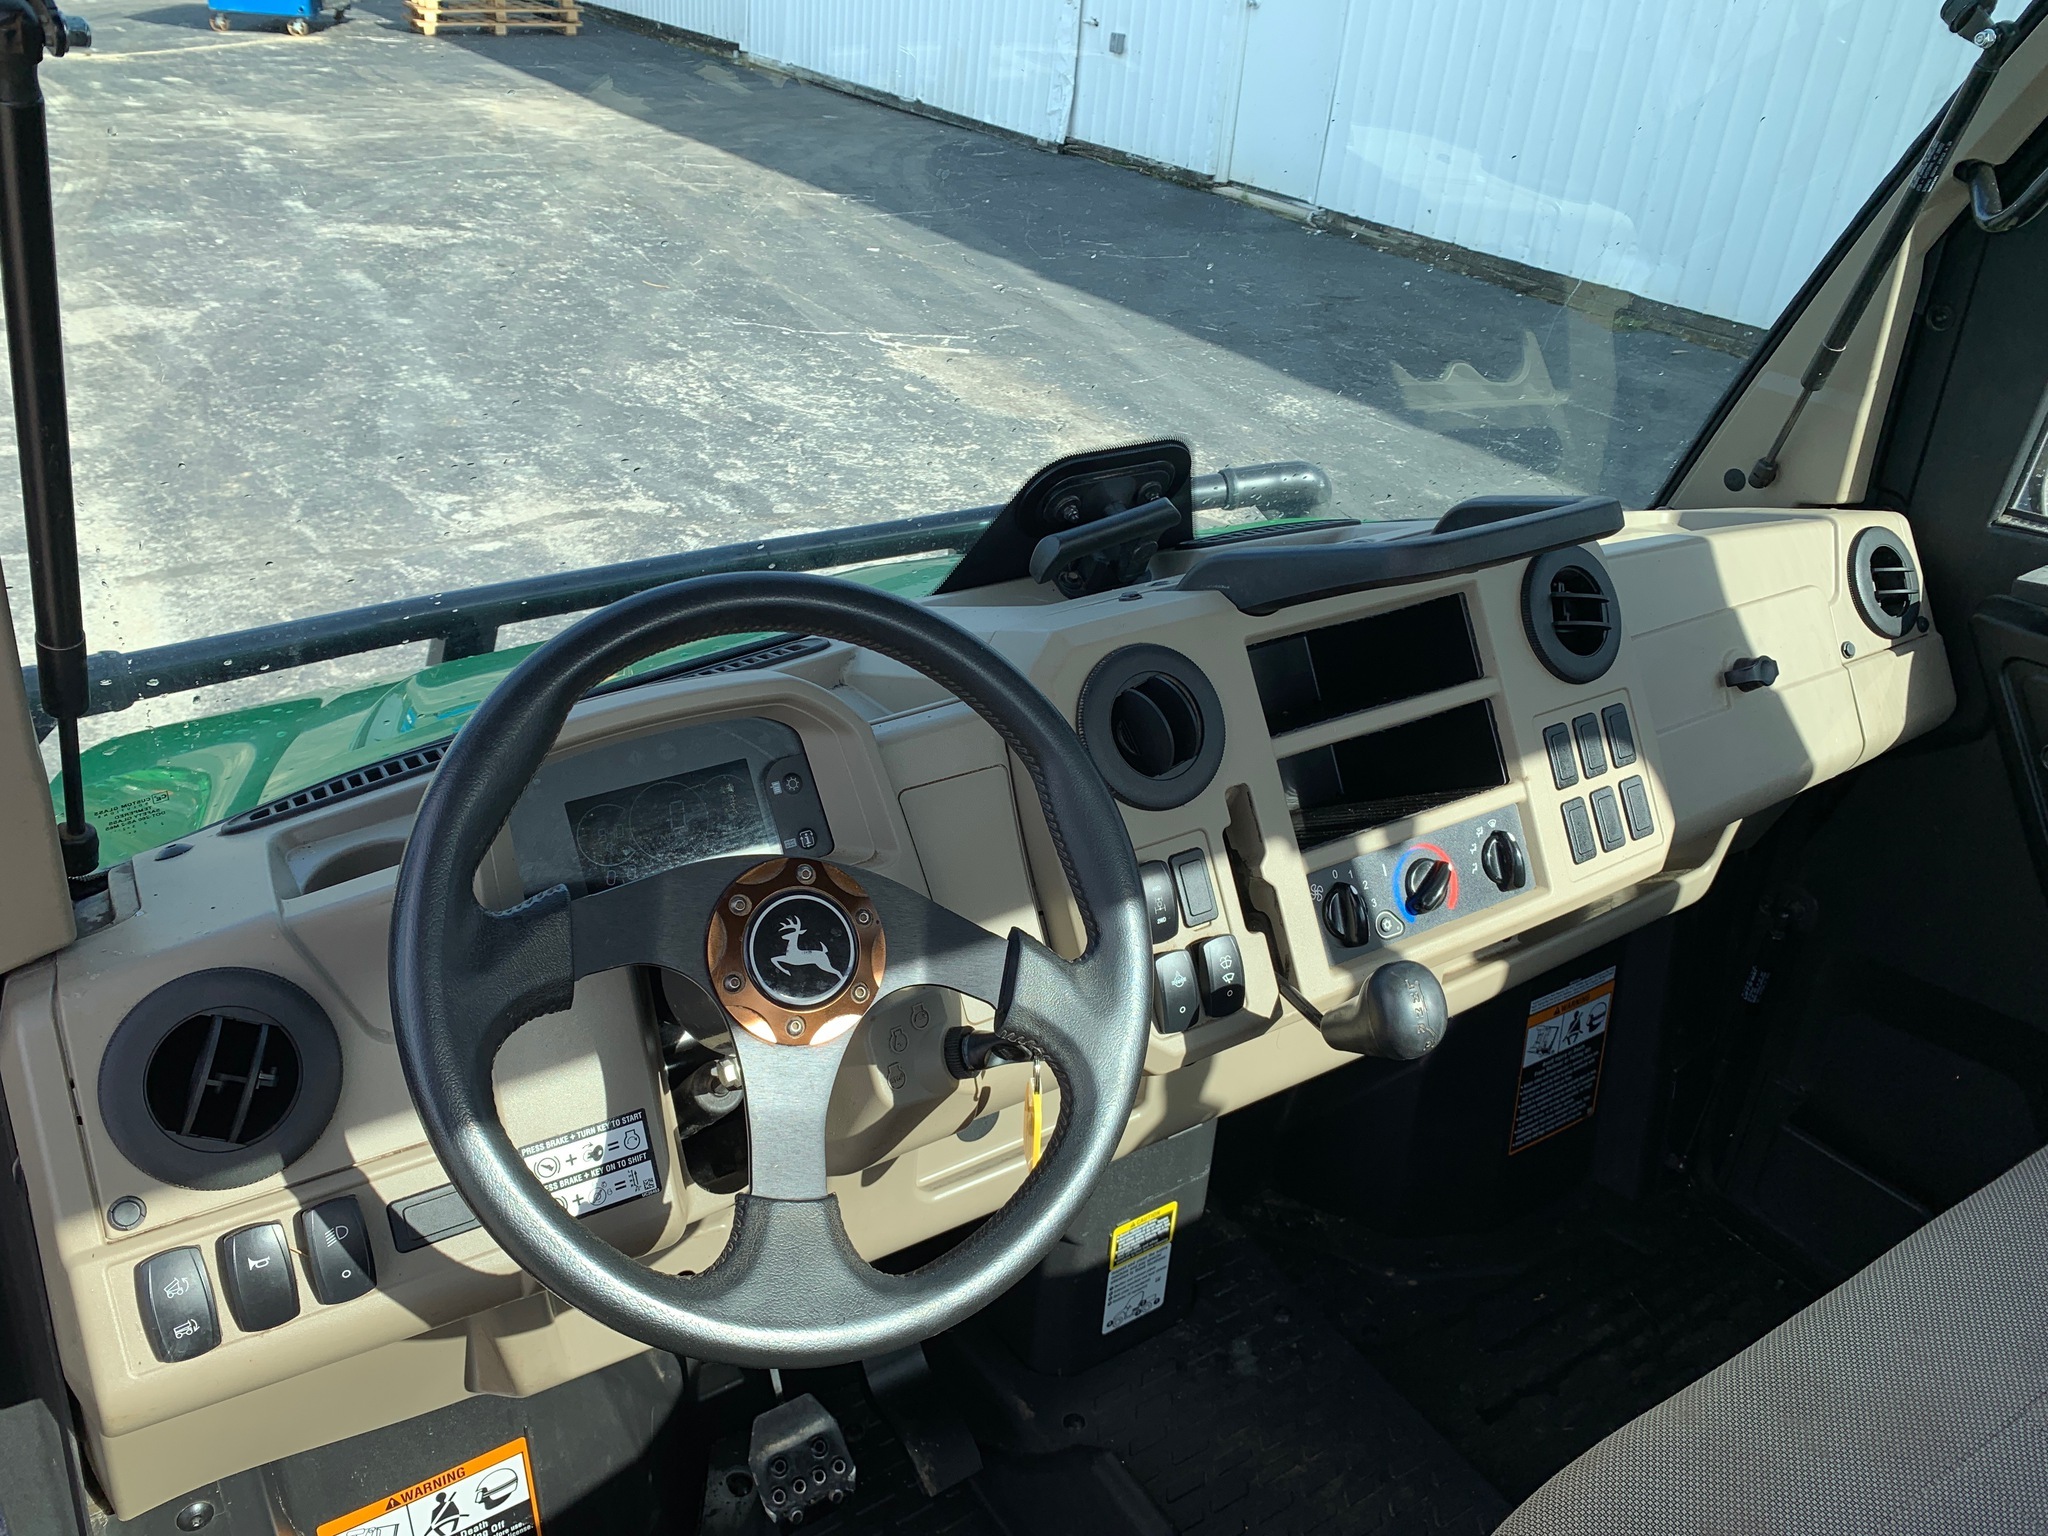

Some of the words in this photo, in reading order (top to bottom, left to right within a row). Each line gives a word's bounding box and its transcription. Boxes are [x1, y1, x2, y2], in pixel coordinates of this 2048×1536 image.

[1348, 869, 1354, 879] 1
[1362, 880, 1369, 890] 2
[1371, 898, 1377, 907] 3
[521, 1145, 545, 1157] PRESS
[546, 1136, 569, 1149] BRAKE
[577, 1127, 596, 1138] TURN
[597, 1122, 610, 1133] KEY
[611, 1119, 621, 1127] TO
[622, 1111, 642, 1125] START
[559, 1175, 583, 1188] BRAKE
[591, 1168, 604, 1178] KEY
[605, 1163, 616, 1172] ON
[617, 1160, 627, 1168] TO
[628, 1152, 647, 1165] SHIFT
[401, 1467, 466, 1503] WARNING
[460, 1521, 489, 1536] Death
[490, 1520, 505, 1533] Off
